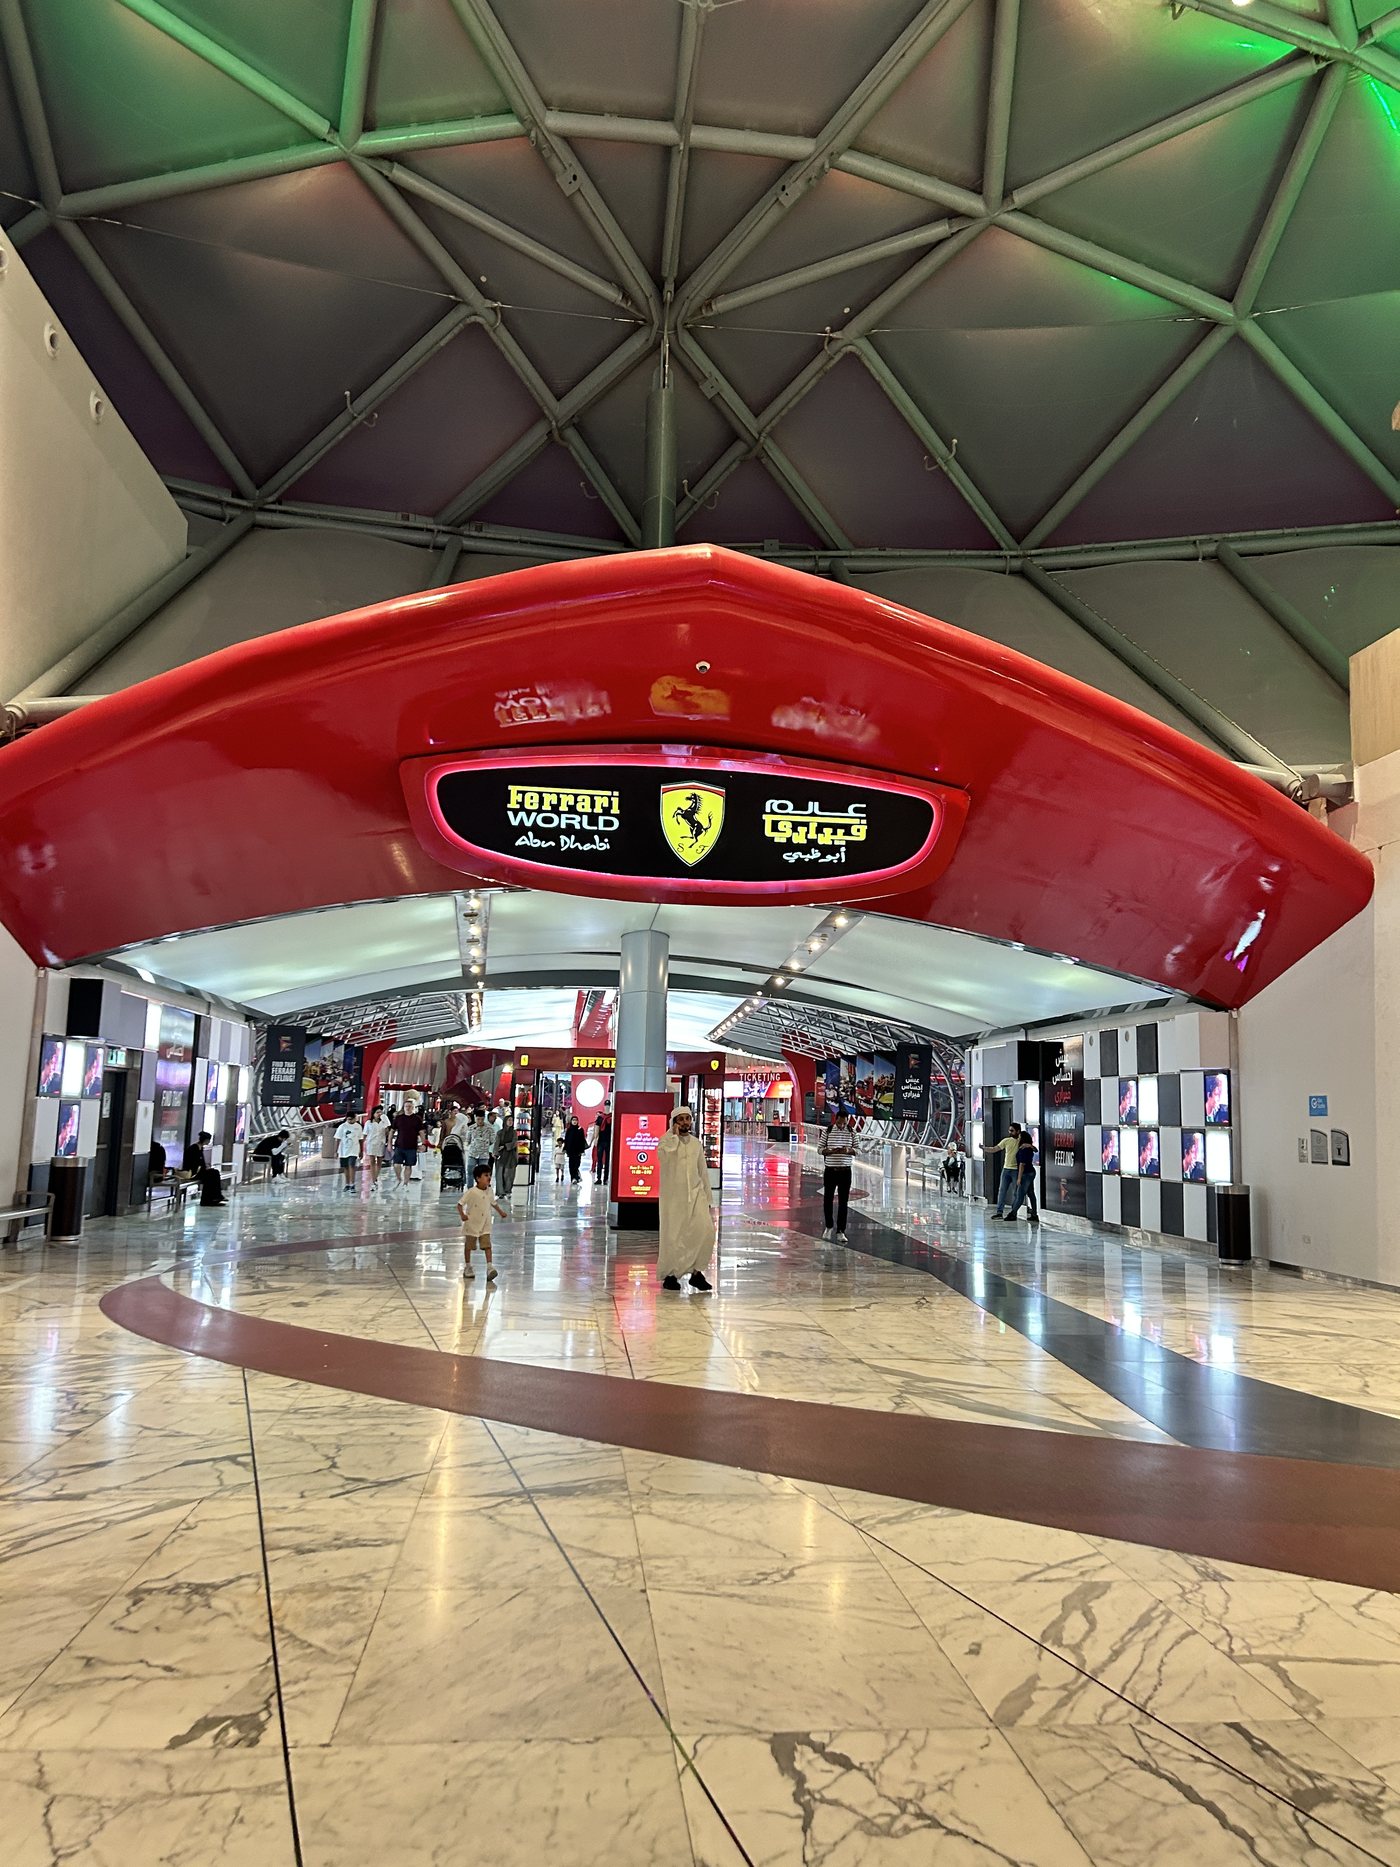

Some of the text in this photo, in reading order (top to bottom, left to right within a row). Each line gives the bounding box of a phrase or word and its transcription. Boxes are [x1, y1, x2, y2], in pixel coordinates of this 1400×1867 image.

[507, 785, 620, 814] Ferrari
[765, 799, 867, 817] عالم
[506, 811, 620, 831] WORLD
[762, 814, 868, 845] فيراري
[514, 831, 610, 851] Abu Dhabi
[271, 1067, 296, 1075] FERRARI
[572, 1056, 616, 1069] Ferrar
[740, 1073, 781, 1081] TICKETING
[1051, 1112, 1077, 1129] FIND THAT
[1054, 1132, 1075, 1148] FERRARI
[1054, 1150, 1075, 1167] FEELING
